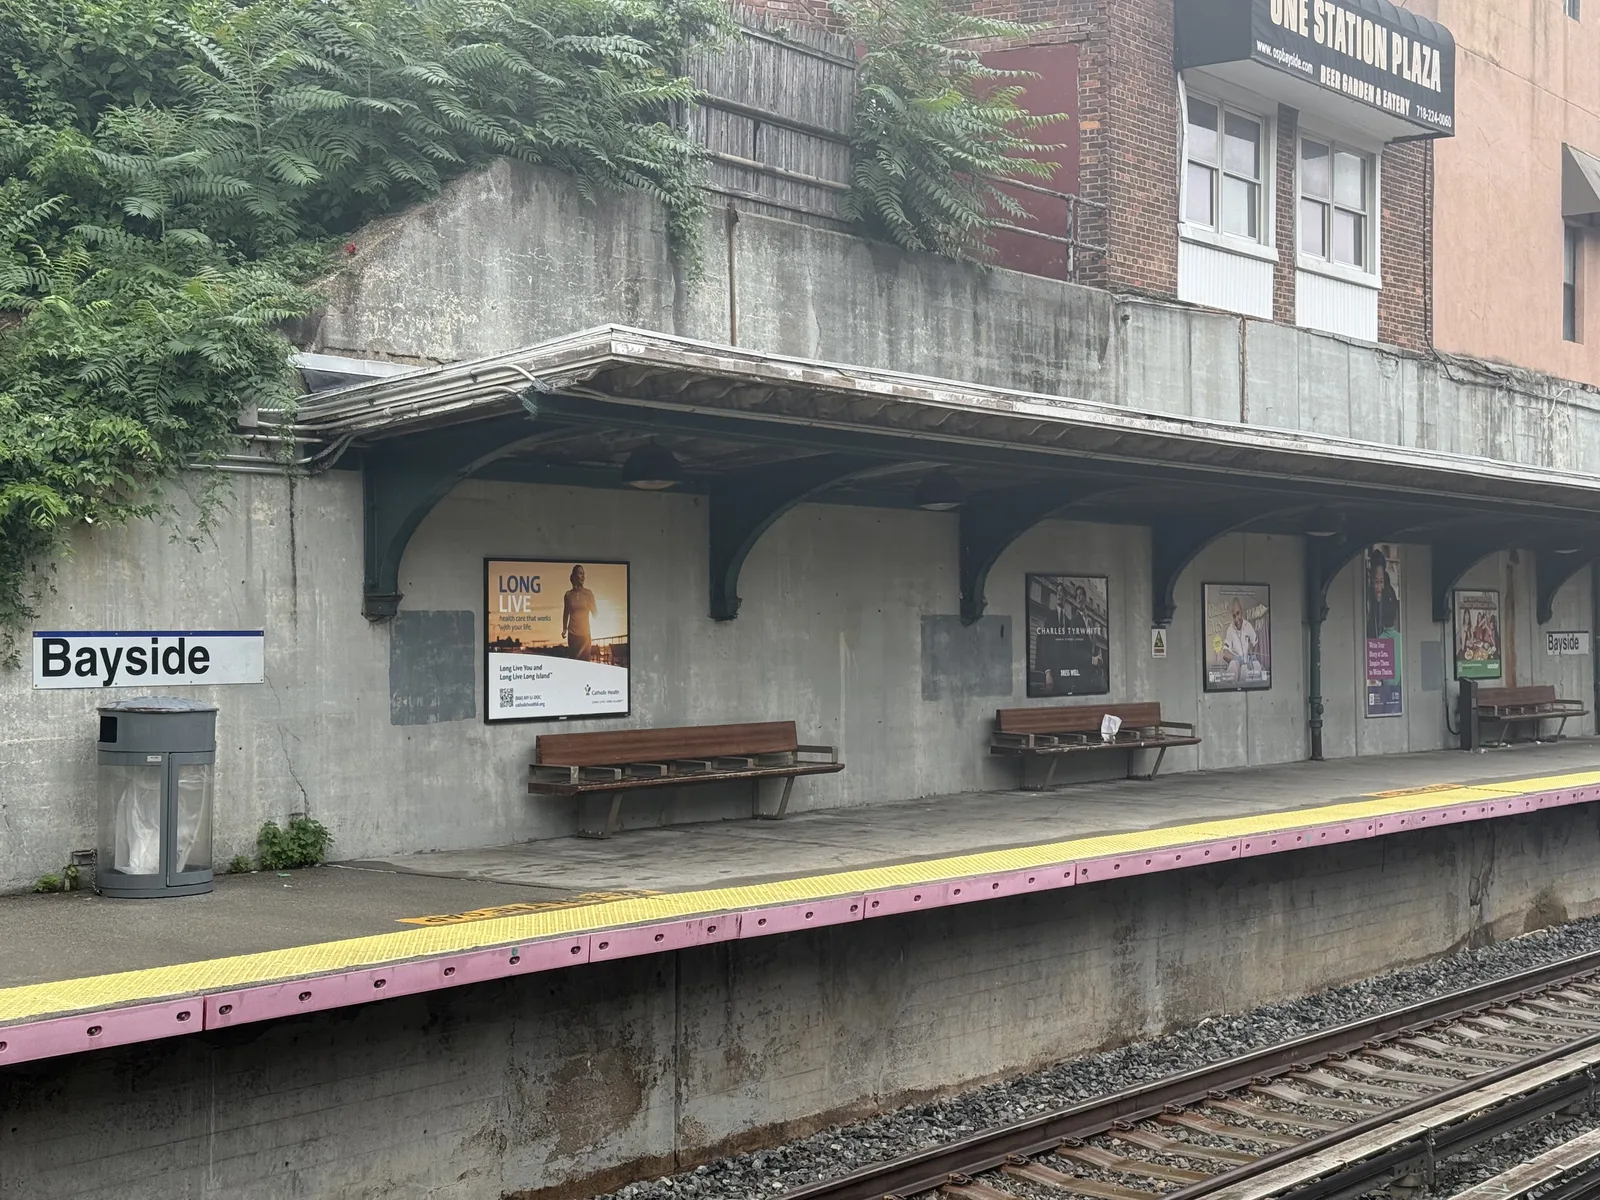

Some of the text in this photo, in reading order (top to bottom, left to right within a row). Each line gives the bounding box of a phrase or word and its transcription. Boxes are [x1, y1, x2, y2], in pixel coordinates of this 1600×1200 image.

[1270, 0, 1442, 93] ONE STATION PLAZA
[1320, 64, 1411, 116] BEER GARDEN & EATERY
[1416, 105, 1452, 128] 718-224-0060
[499, 575, 541, 593] LONG
[499, 595, 531, 613] LIVE
[1036, 627, 1101, 635] CHARLES TYRWHITT
[1548, 634, 1580, 654] Bayside
[41, 637, 211, 687] Bayside
[499, 665, 512, 673] Long
